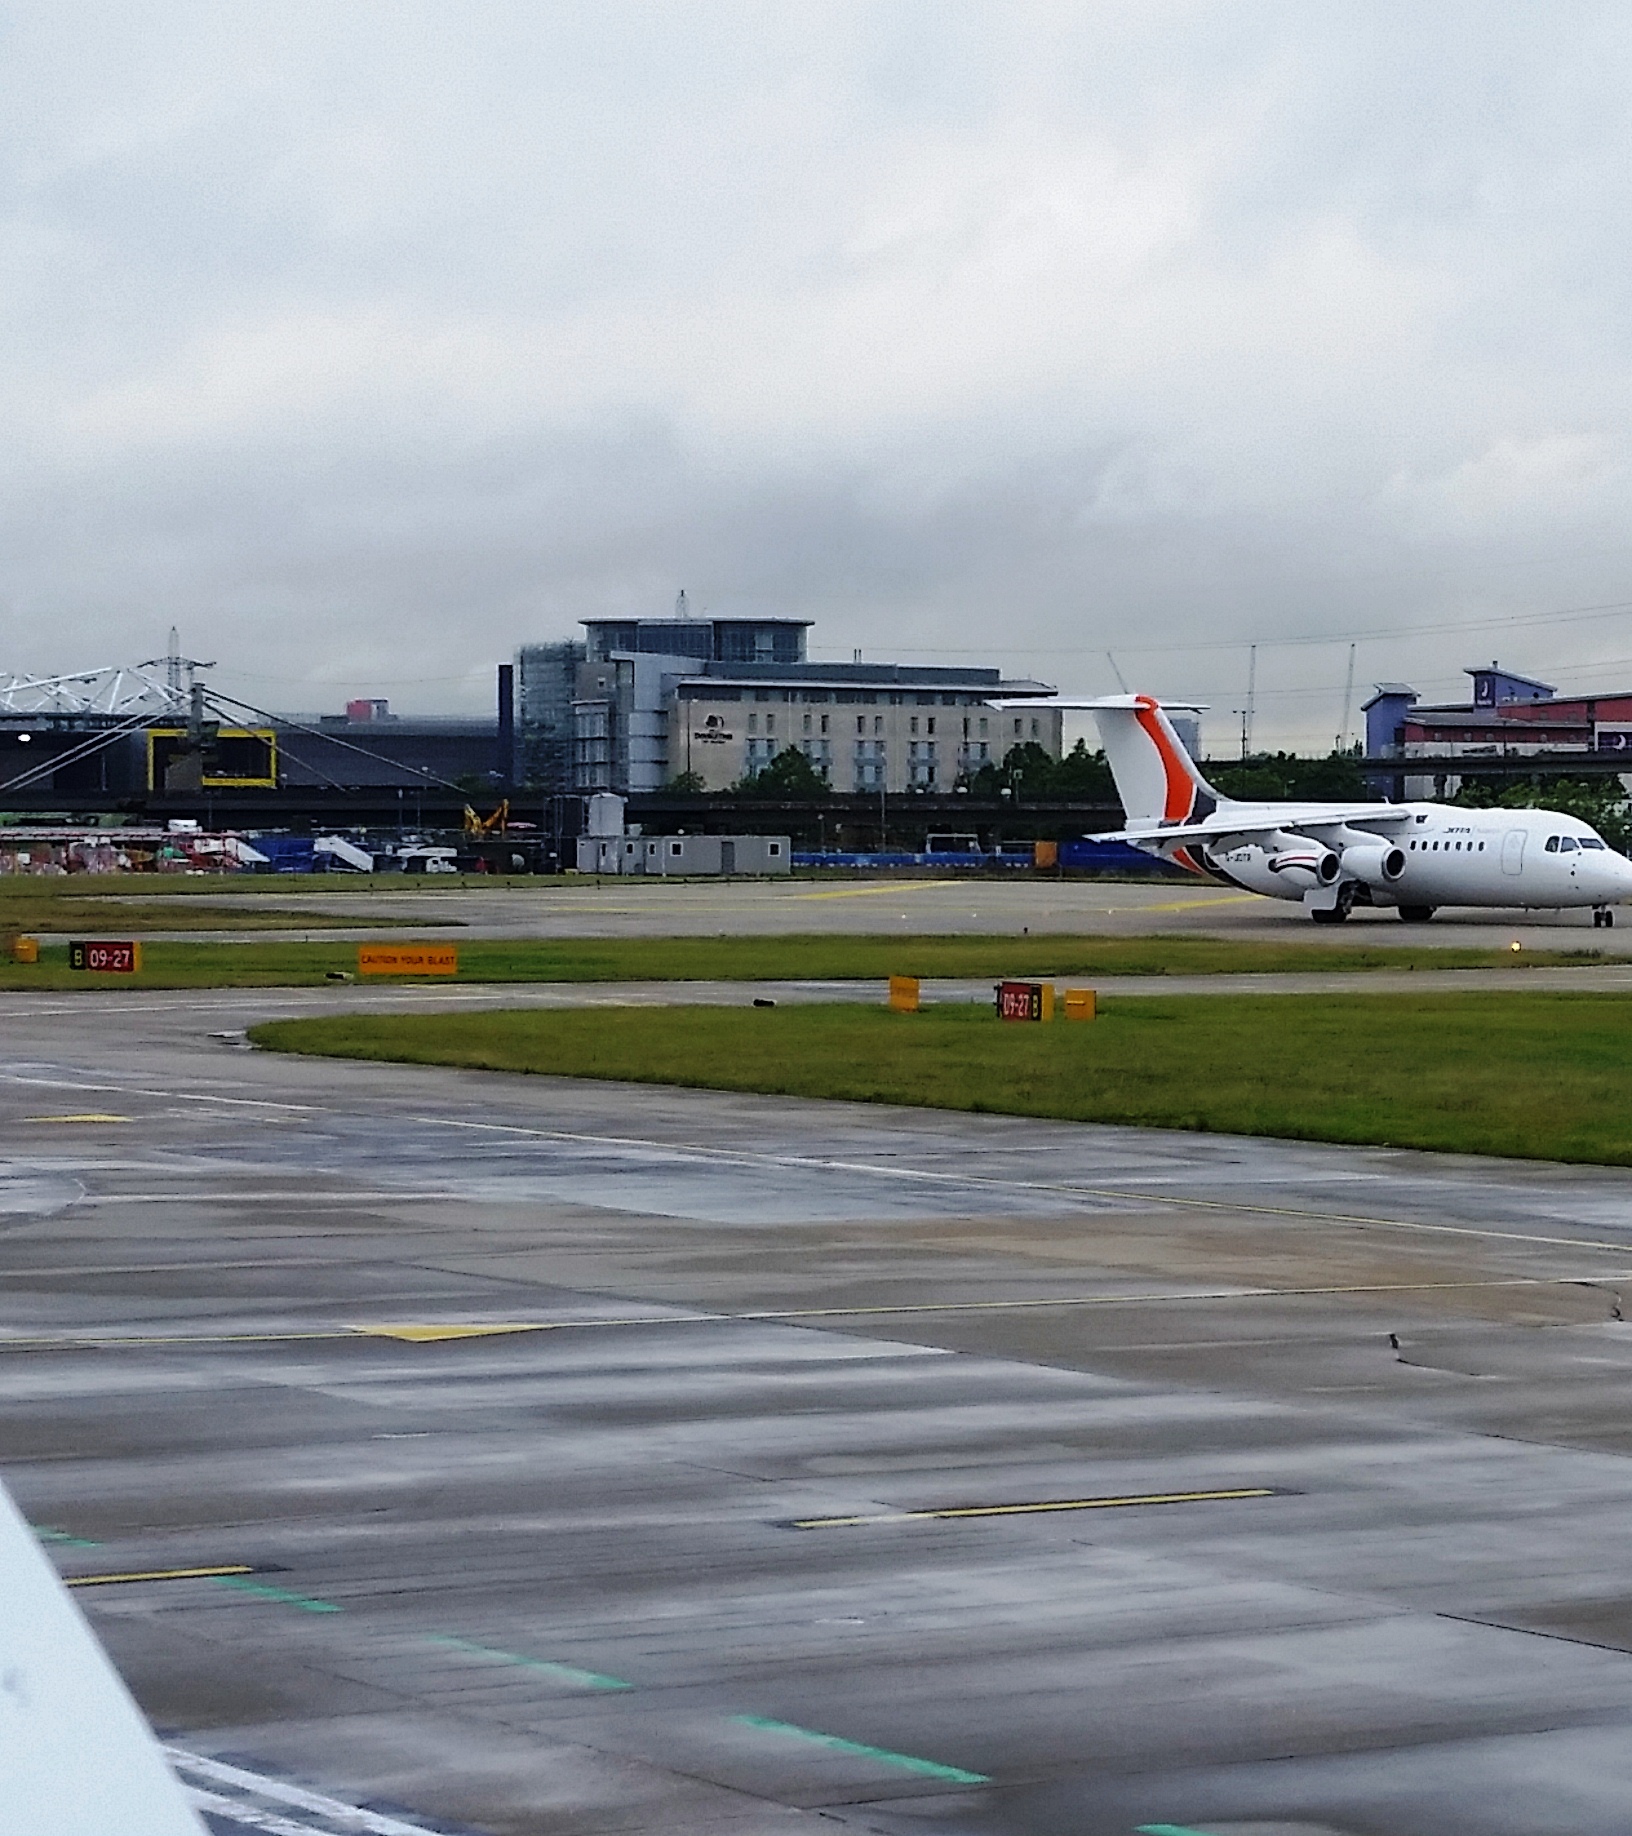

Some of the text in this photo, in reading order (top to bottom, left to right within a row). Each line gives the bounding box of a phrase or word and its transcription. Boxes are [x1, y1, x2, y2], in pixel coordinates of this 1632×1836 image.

[74, 949, 130, 968] B 09-27
[401, 955, 424, 964] YOUR
[427, 956, 455, 965] BLAST
[1003, 993, 1039, 1018] 09-27 B
